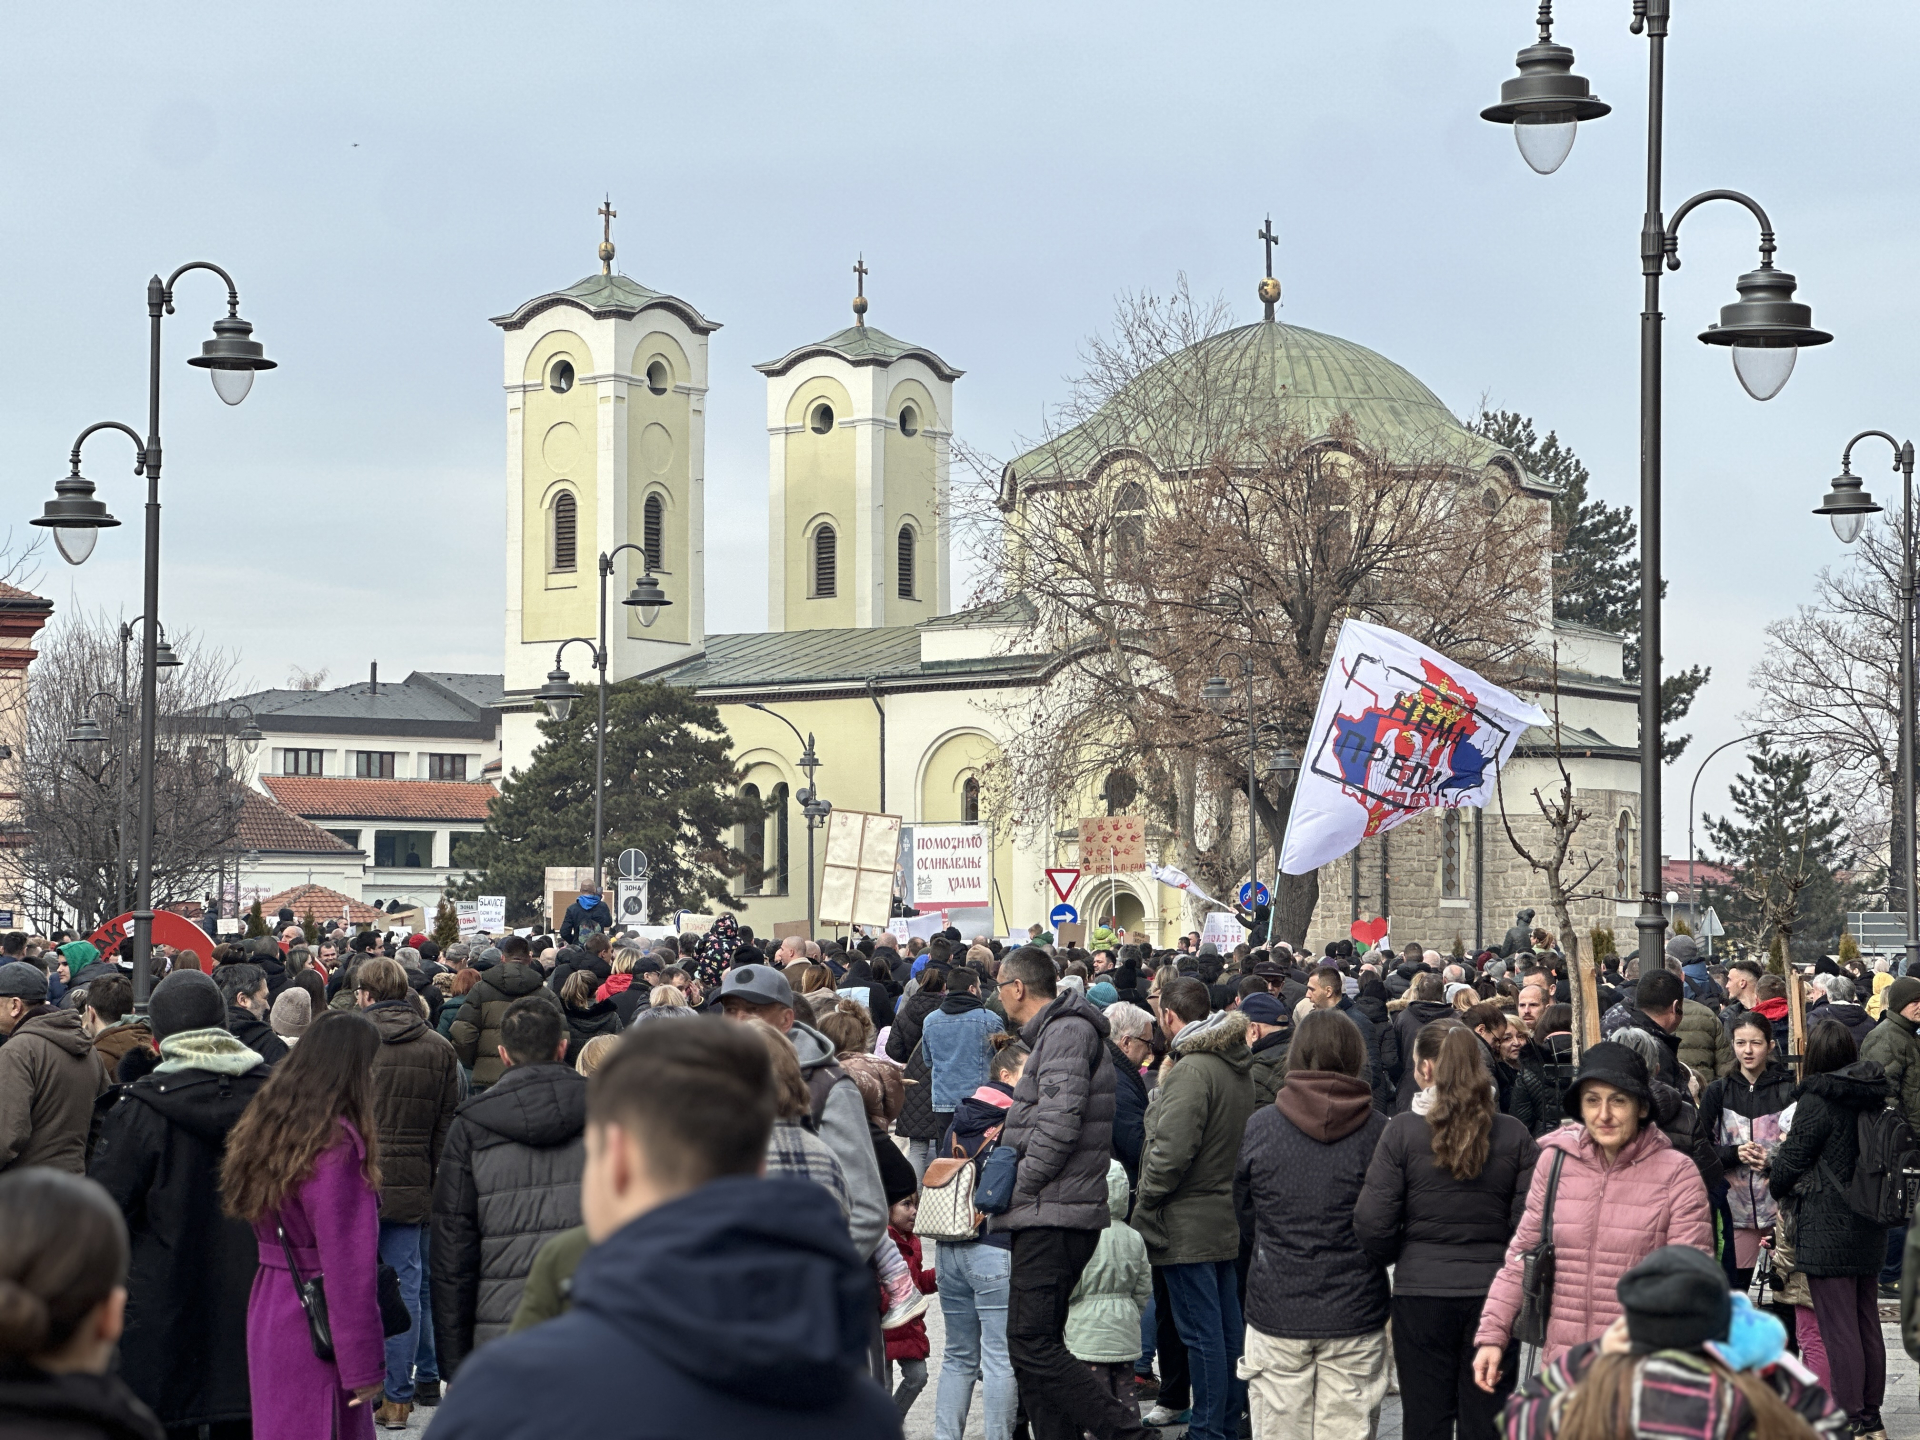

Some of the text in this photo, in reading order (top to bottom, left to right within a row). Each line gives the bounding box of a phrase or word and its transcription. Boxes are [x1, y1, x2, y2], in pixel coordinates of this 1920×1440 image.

[1388, 690, 1466, 753] НЕМА
[1095, 864, 1119, 874] НЕМА
[624, 884, 642, 892] ЗОНА
[947, 875, 981, 893] ХРАМА
